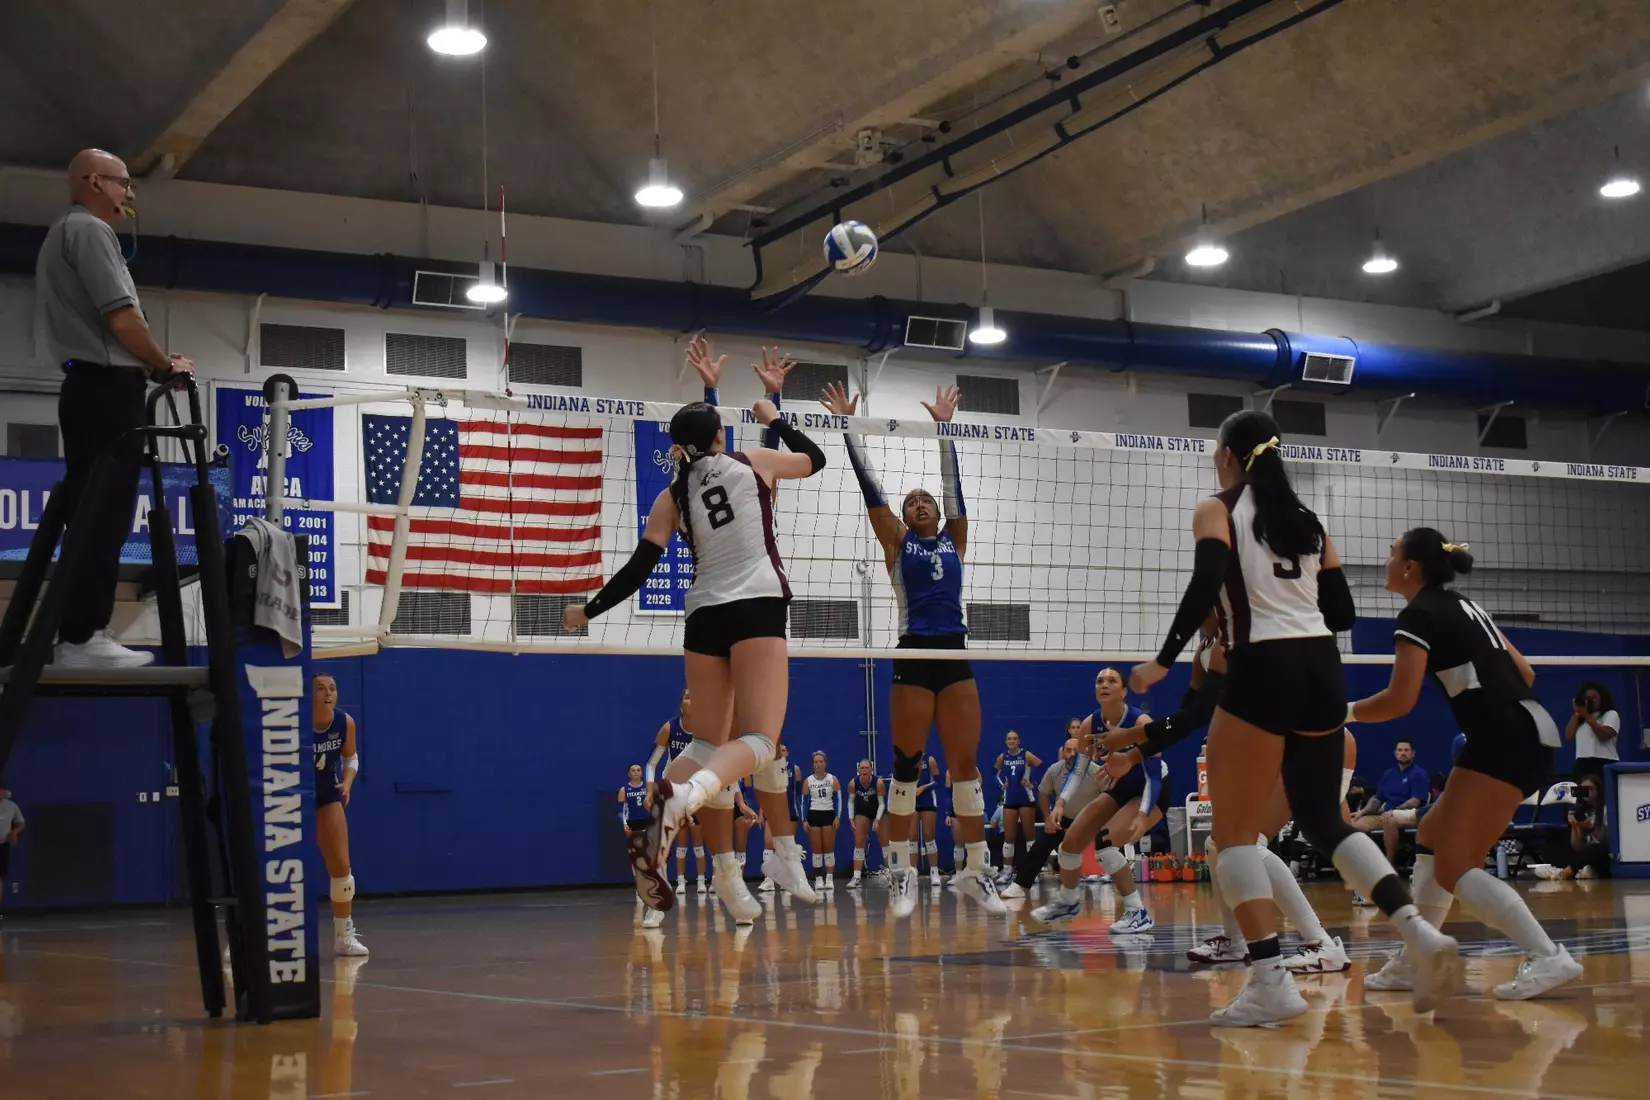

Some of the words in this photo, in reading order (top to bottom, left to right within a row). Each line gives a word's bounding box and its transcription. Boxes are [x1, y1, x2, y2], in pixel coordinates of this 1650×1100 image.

[526, 394, 590, 413] INDIANA
[596, 399, 645, 416] STATE
[742, 409, 798, 427] INNA
[804, 413, 849, 430] STATE
[936, 422, 989, 439] INDIANA
[994, 426, 1035, 442] STATE
[1115, 434, 1165, 450] INDIANA
[1168, 438, 1205, 453] STATE
[1282, 445, 1323, 460] NDIANA
[1326, 448, 1361, 463] STATE
[1428, 455, 1471, 470] INDIANA
[1473, 458, 1505, 472] STATE
[1567, 463, 1605, 477] INDIANA
[1607, 466, 1637, 480] STATE
[701, 485, 735, 530] 8
[299, 516, 327, 529] 2001
[930, 554, 944, 581] 3
[646, 578, 671, 589] 2023
[646, 594, 672, 605] 2026
[1458, 599, 1508, 650] 11
[1010, 766, 1017, 776] 7
[636, 796, 643, 806] 2
[818, 788, 827, 798] 16
[266, 858, 306, 984] STATE
